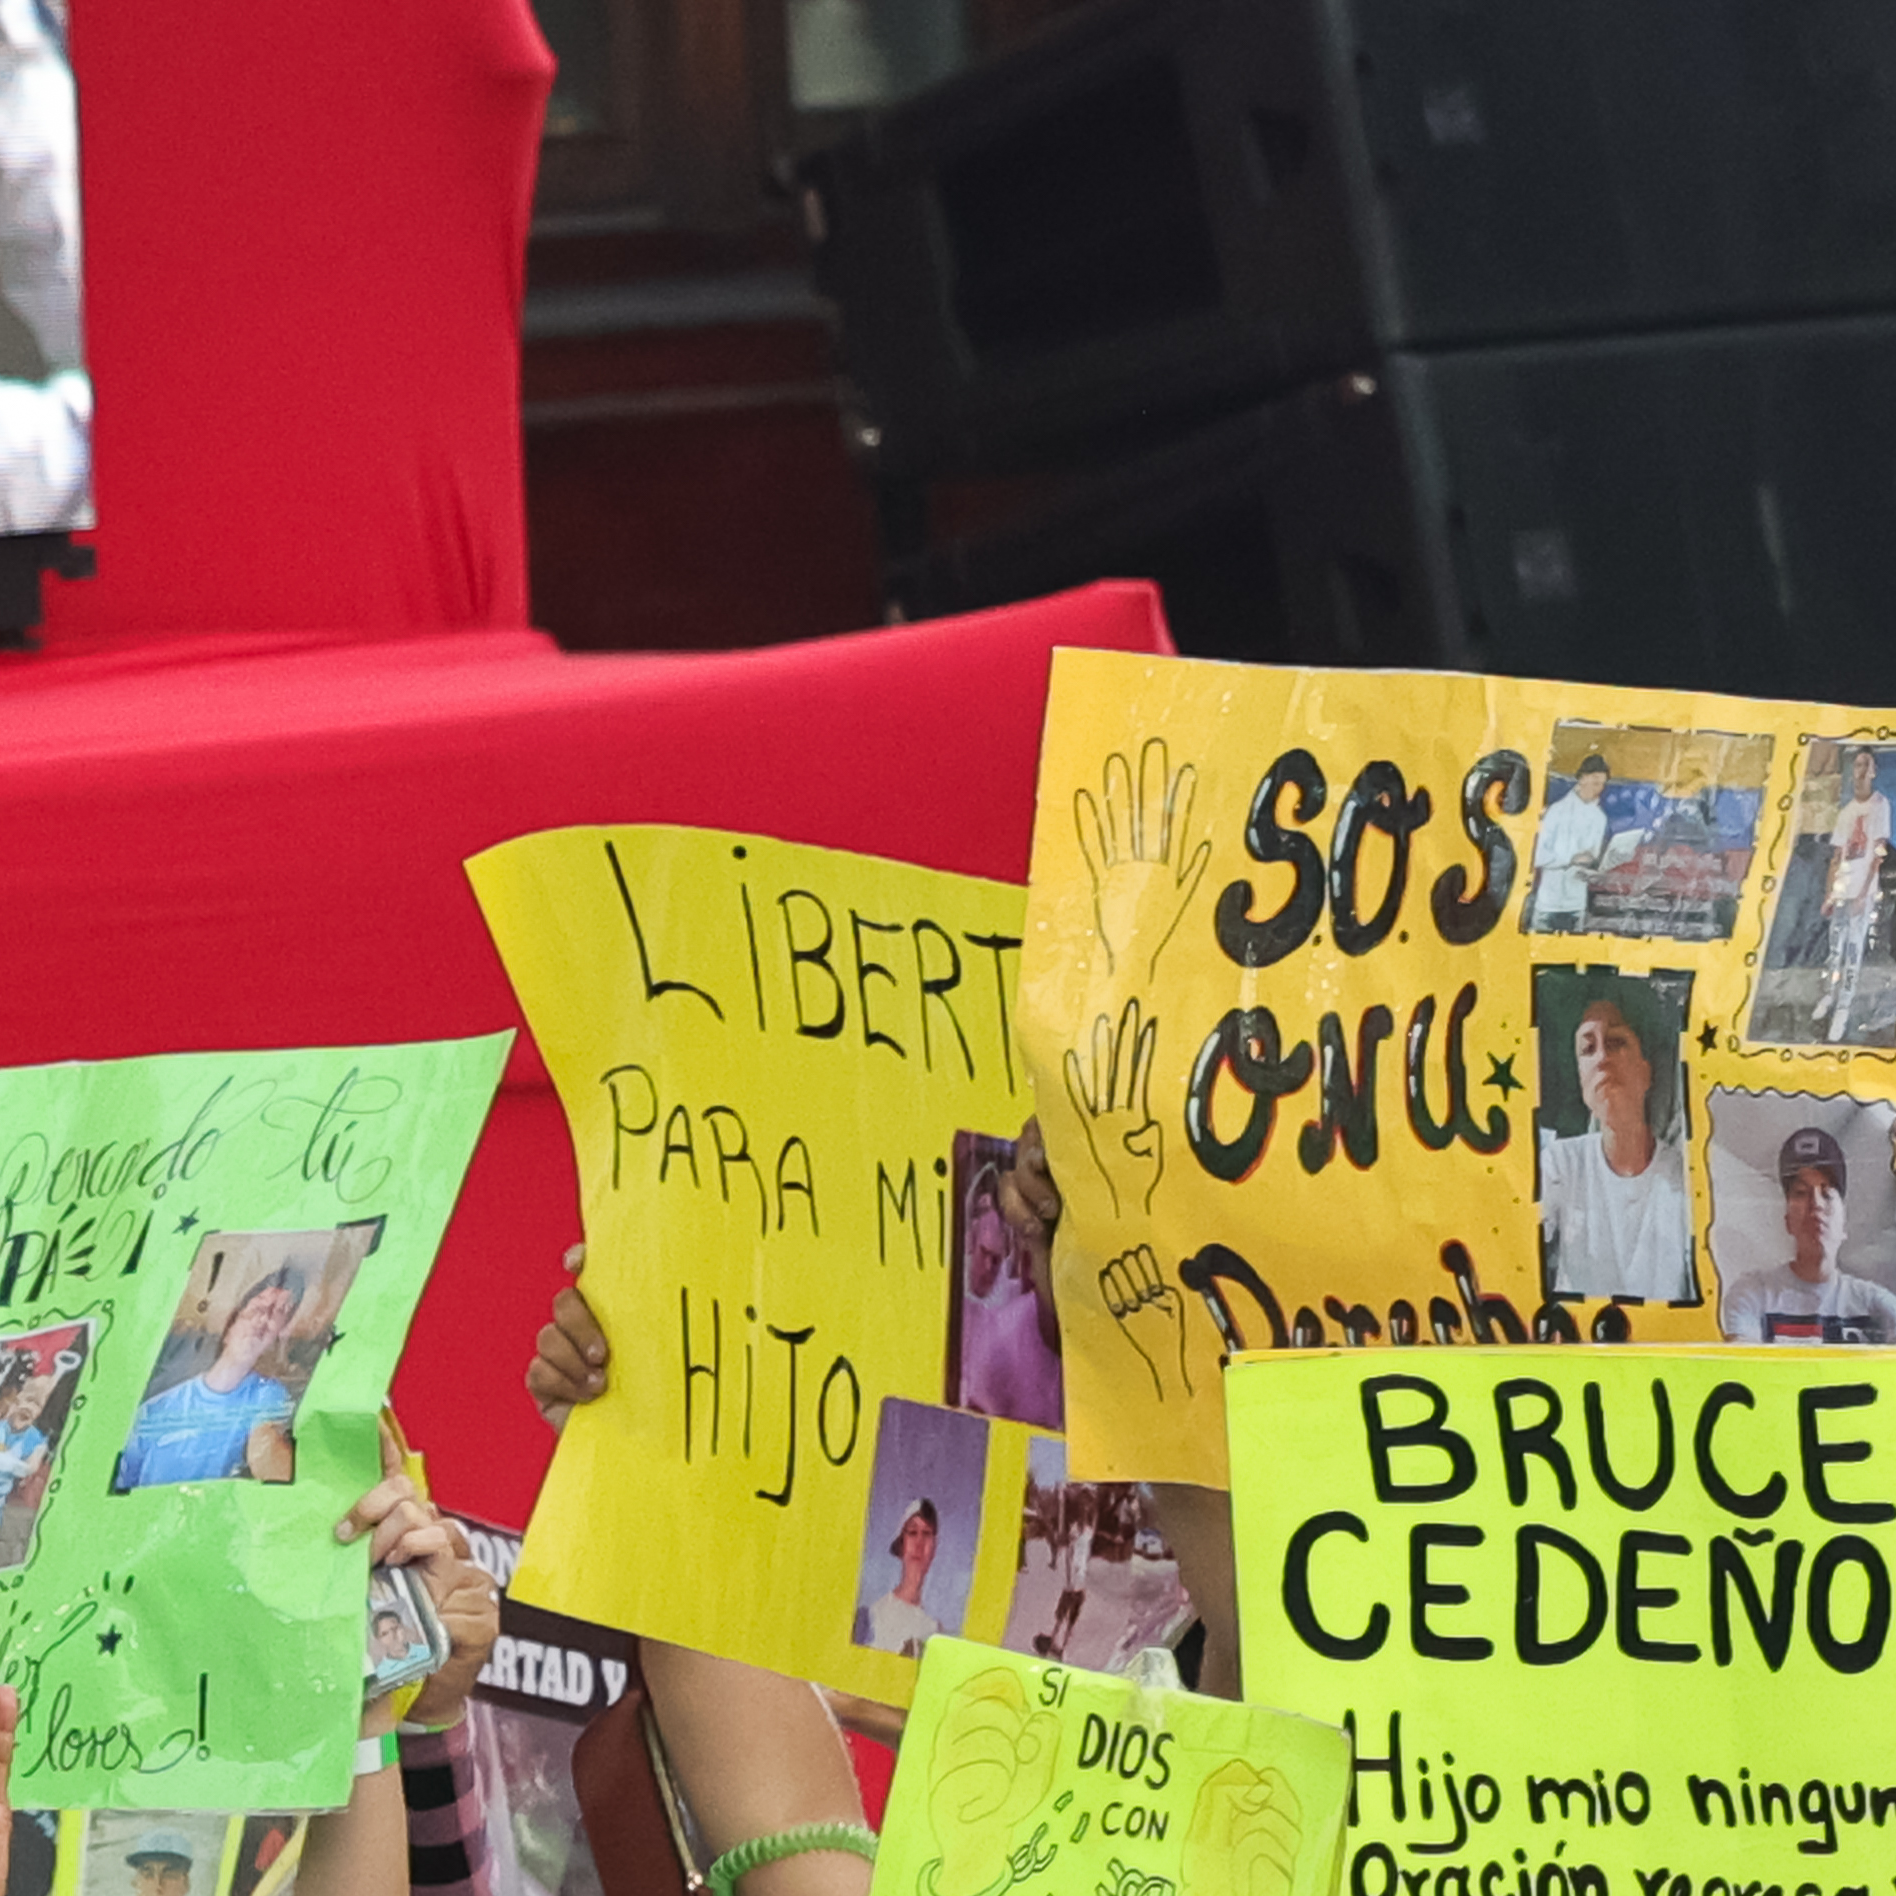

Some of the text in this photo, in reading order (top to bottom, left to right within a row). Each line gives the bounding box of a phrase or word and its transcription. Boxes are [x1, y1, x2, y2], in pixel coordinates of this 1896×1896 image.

[599, 1064, 821, 1240] PARA
[1183, 978, 1509, 1184] ONU
[1359, 1374, 1896, 1524] BRUCE
[1281, 1508, 1893, 1674] CEDEÑO
[1037, 1666, 1072, 1709] SI
[1075, 1712, 1175, 1792] DIOS
[1101, 1800, 1170, 1842] CON
[1344, 1708, 1503, 1855] Hijo
